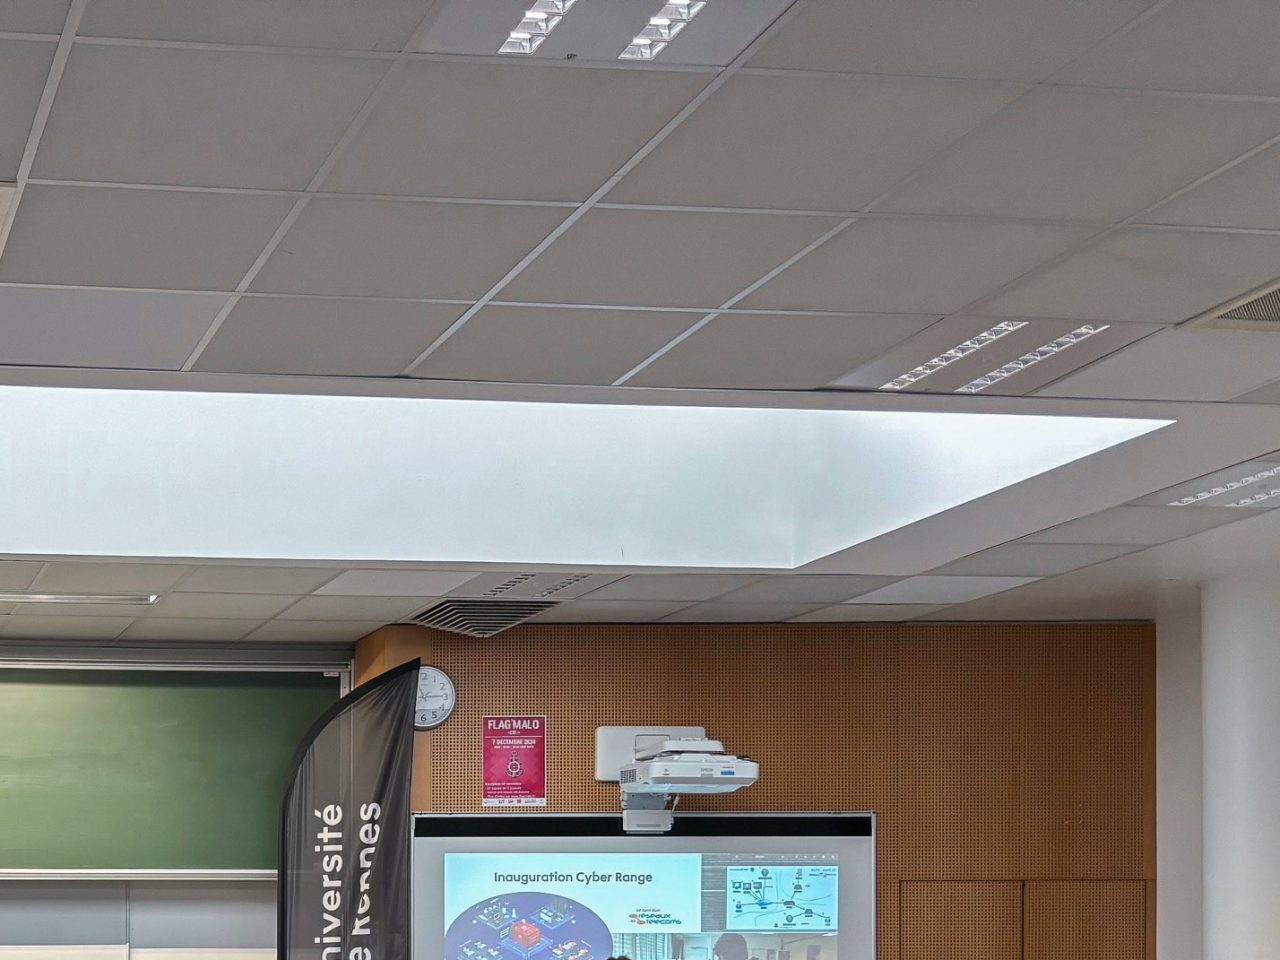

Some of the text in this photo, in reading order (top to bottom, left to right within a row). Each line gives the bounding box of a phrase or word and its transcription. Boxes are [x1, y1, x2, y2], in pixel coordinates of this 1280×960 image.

[442, 693, 448, 701] 3
[488, 719, 539, 730] FLAG'MALO
[494, 872, 653, 885] Inauguration Cyber Range
